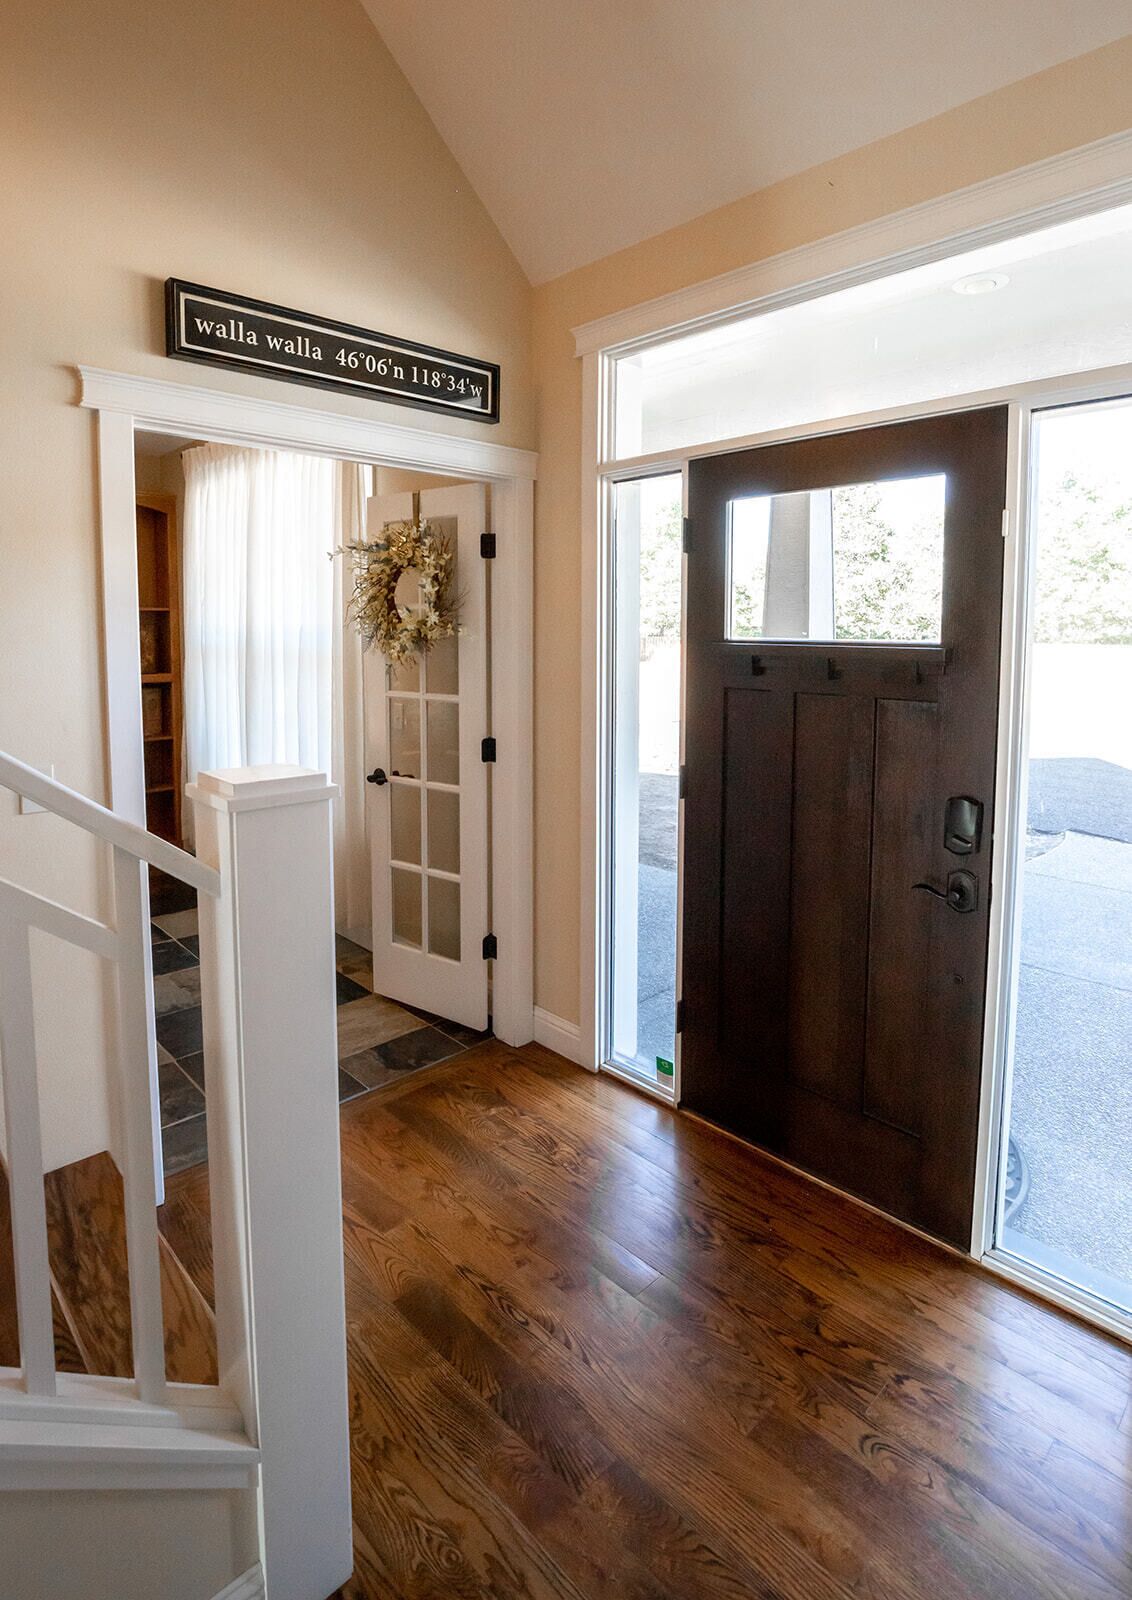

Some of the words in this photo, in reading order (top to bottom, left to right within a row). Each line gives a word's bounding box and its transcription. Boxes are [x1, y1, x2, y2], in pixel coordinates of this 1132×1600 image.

[194, 317, 259, 347] walla
[265, 333, 323, 361] walla
[335, 347, 405, 380] 46°06'n
[411, 366, 484, 398] 118°34'w
